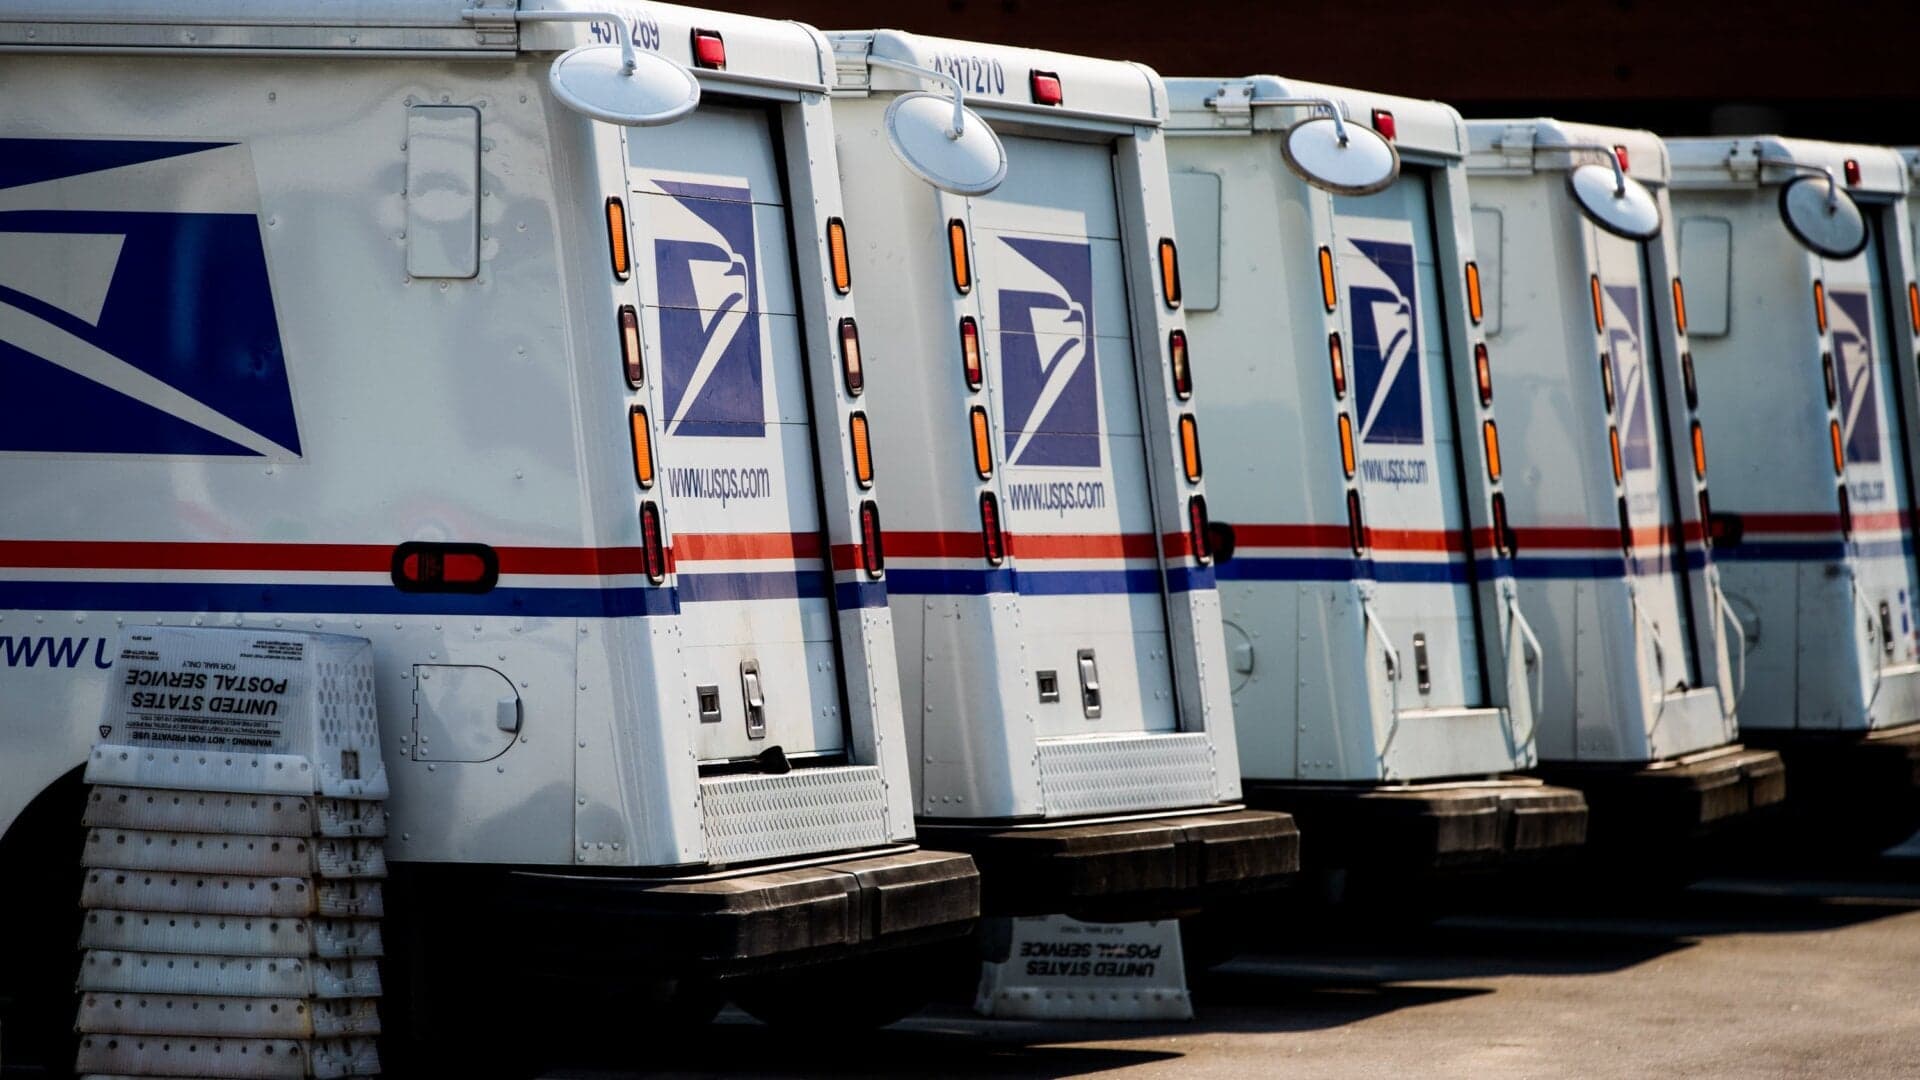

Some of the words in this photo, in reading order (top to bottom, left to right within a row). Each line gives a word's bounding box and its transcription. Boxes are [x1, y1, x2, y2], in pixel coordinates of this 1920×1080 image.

[667, 467, 770, 509] www.usps.com
[1008, 481, 1105, 519] www.usps.com
[182, 661, 201, 669] ONLY
[204, 662, 219, 670] MAIL
[125, 670, 207, 688] SERVICE
[213, 675, 288, 694] POSTAL
[131, 692, 204, 710] STATES
[209, 697, 278, 716] UNITED
[132, 731, 150, 740] USE
[152, 733, 186, 742] PRIVATE
[188, 735, 206, 743] FOR
[208, 736, 225, 744] NOT
[1021, 942, 1092, 957] SERVICE
[1026, 961, 1090, 976] STATES
[1095, 962, 1154, 977] UNITED
